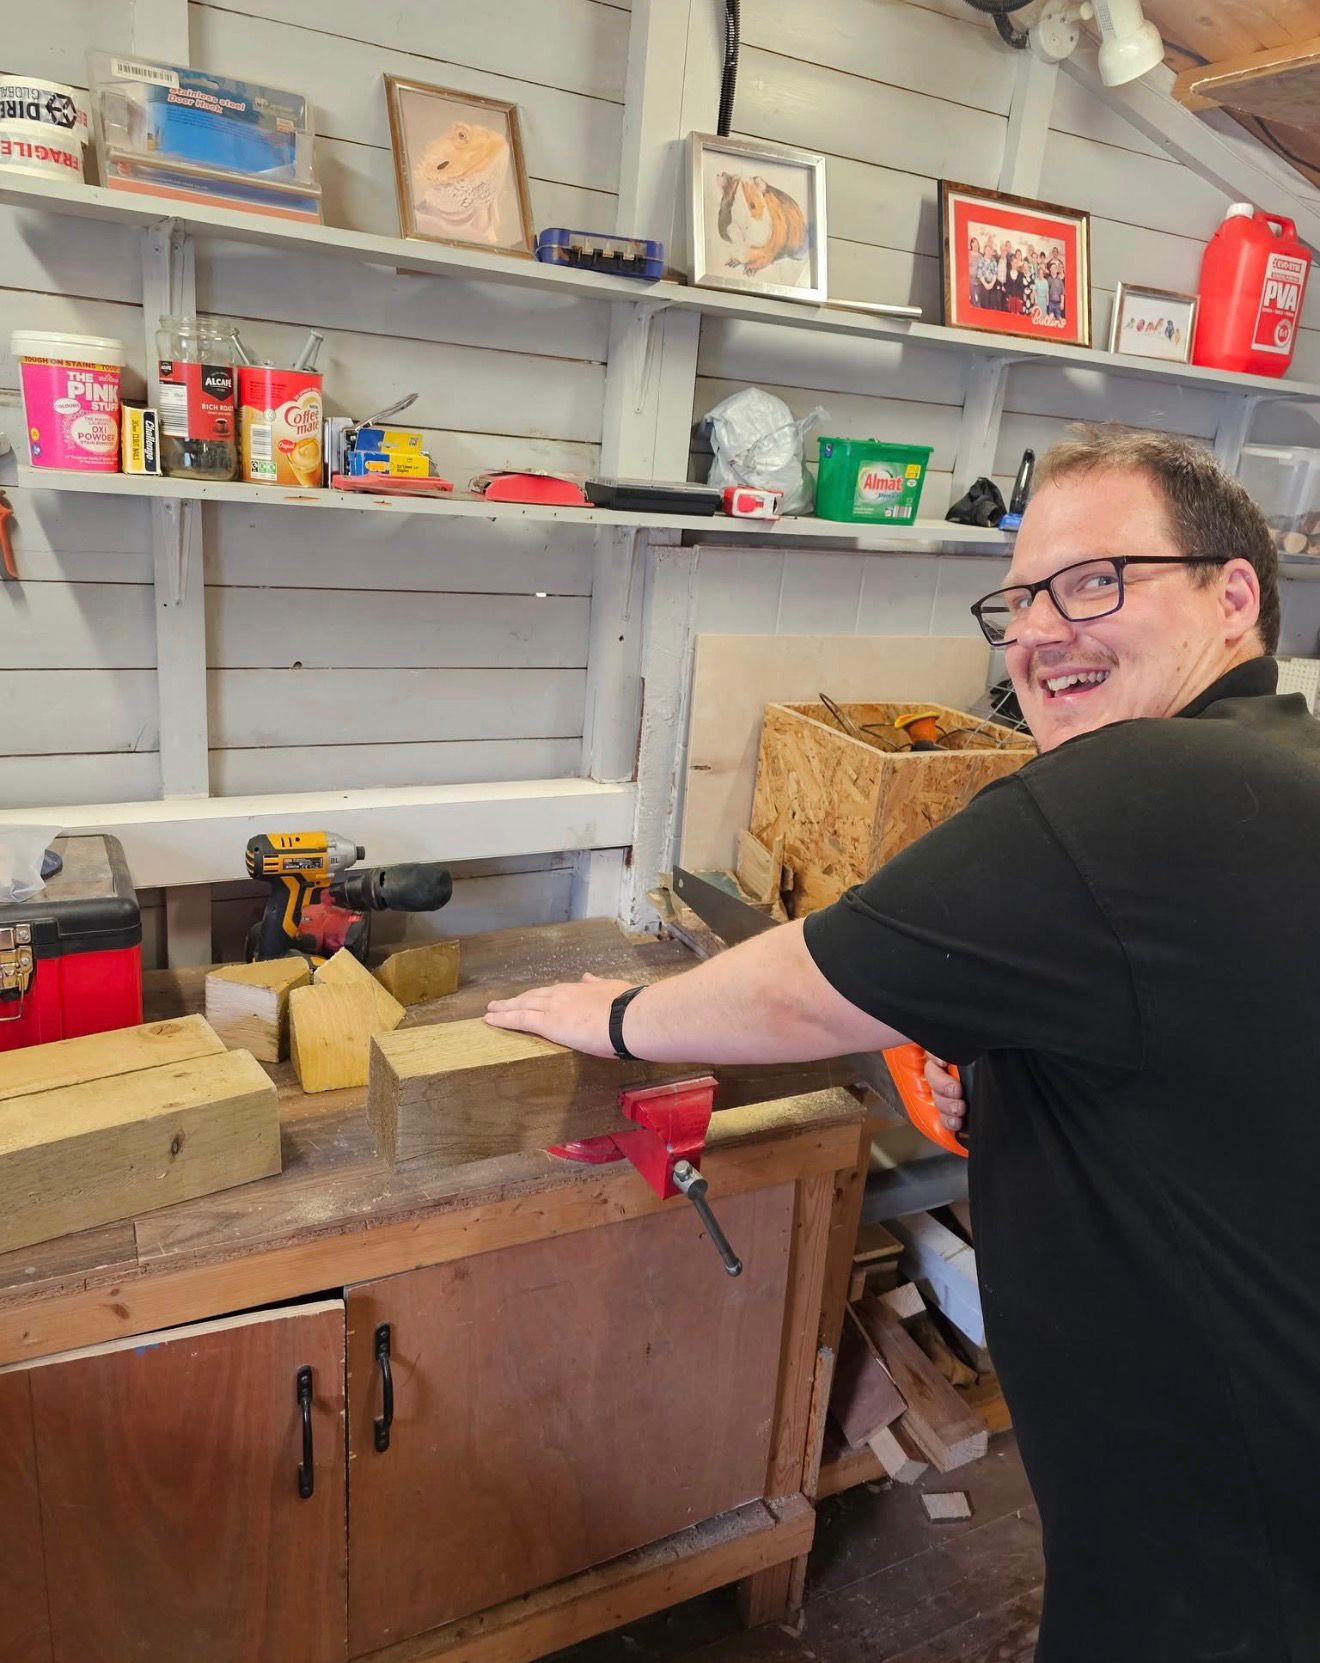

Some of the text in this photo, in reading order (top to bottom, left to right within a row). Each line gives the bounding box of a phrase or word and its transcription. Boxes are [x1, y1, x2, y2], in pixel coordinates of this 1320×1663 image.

[168, 94, 223, 113] Door Hook
[219, 98, 246, 111] steel
[0, 140, 80, 170] FRAGILE
[1263, 280, 1298, 312] PVA
[24, 355, 48, 364] TOUGH
[65, 360, 96, 369] STAINS
[67, 371, 94, 382] THE
[67, 381, 119, 402] PINK
[863, 473, 904, 491] Almat
